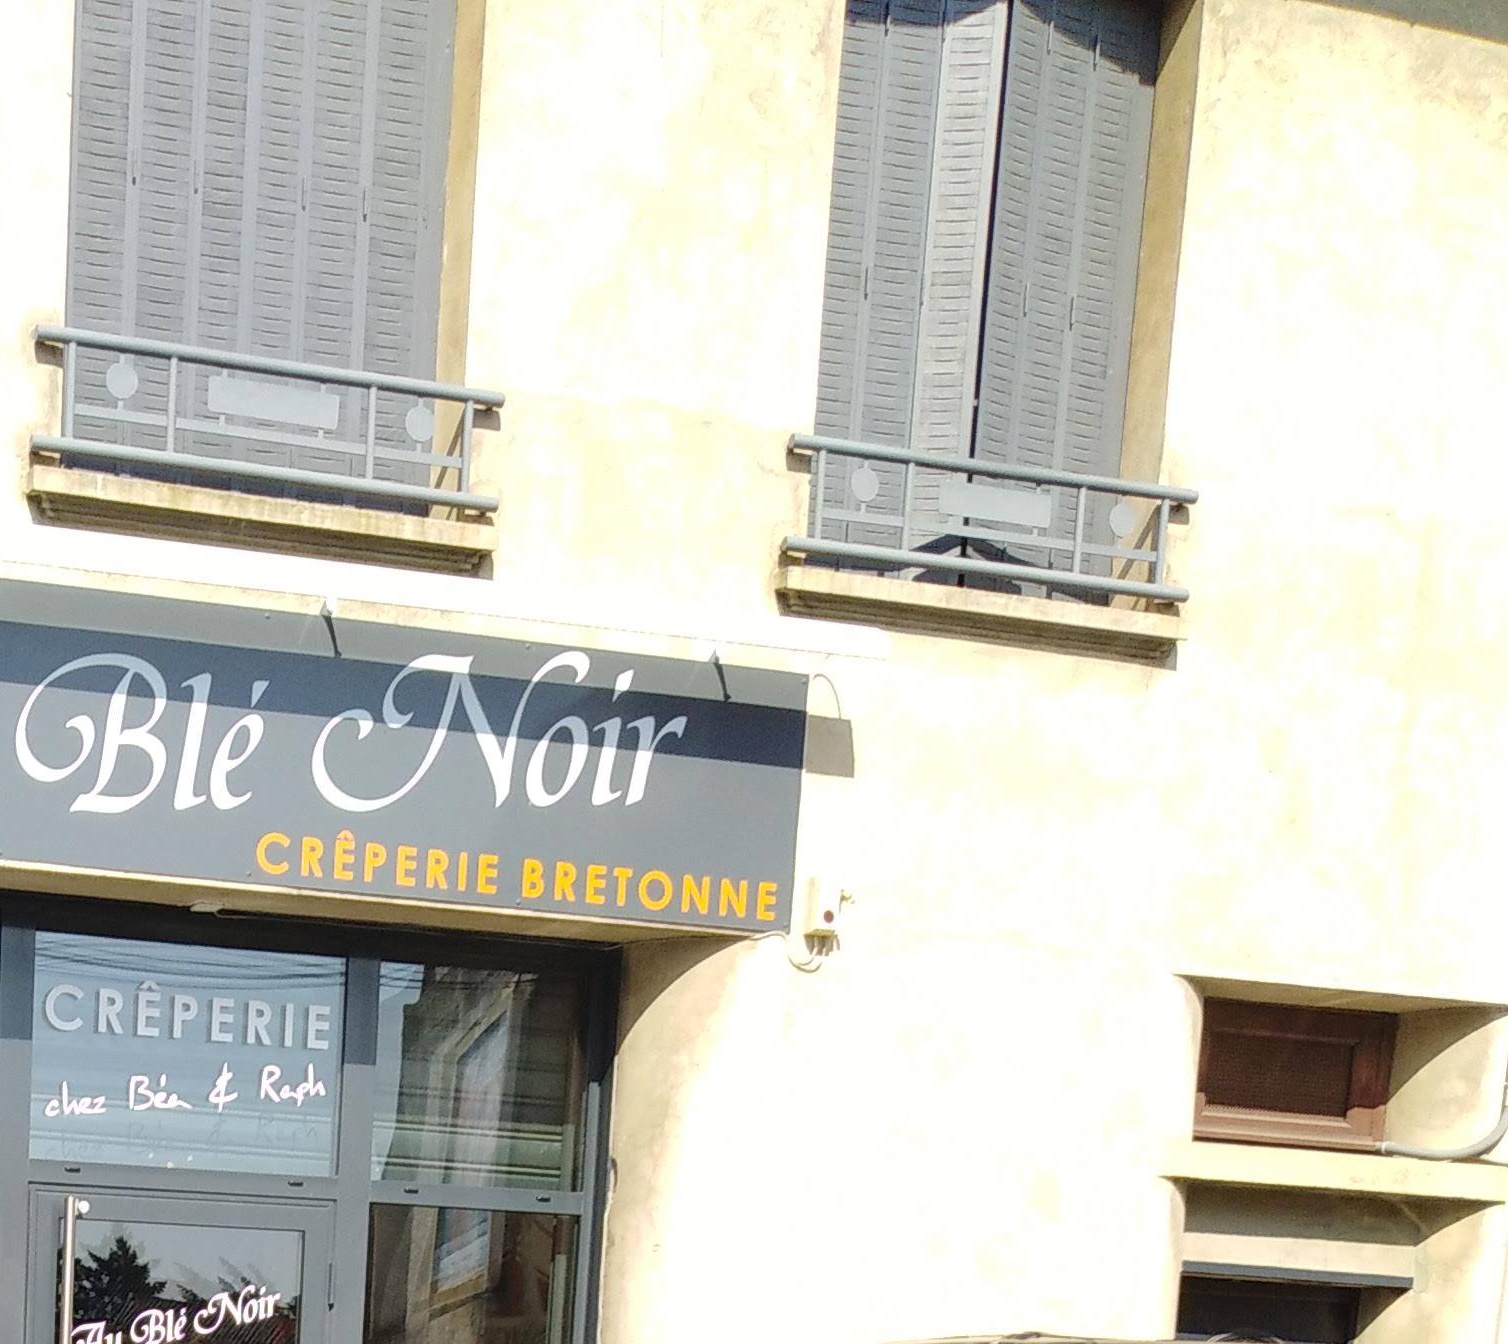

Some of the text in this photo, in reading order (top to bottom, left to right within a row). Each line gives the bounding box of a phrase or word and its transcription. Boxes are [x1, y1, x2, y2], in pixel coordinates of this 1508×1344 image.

[15, 652, 270, 814] Blé
[311, 650, 688, 812] Noir
[255, 830, 778, 921] CRÊPERIE BRETONNE
[44, 980, 330, 1050] CRÊPERIE
[44, 1081, 107, 1118] chez
[208, 1061, 238, 1113] &
[193, 1284, 281, 1335] Noir
